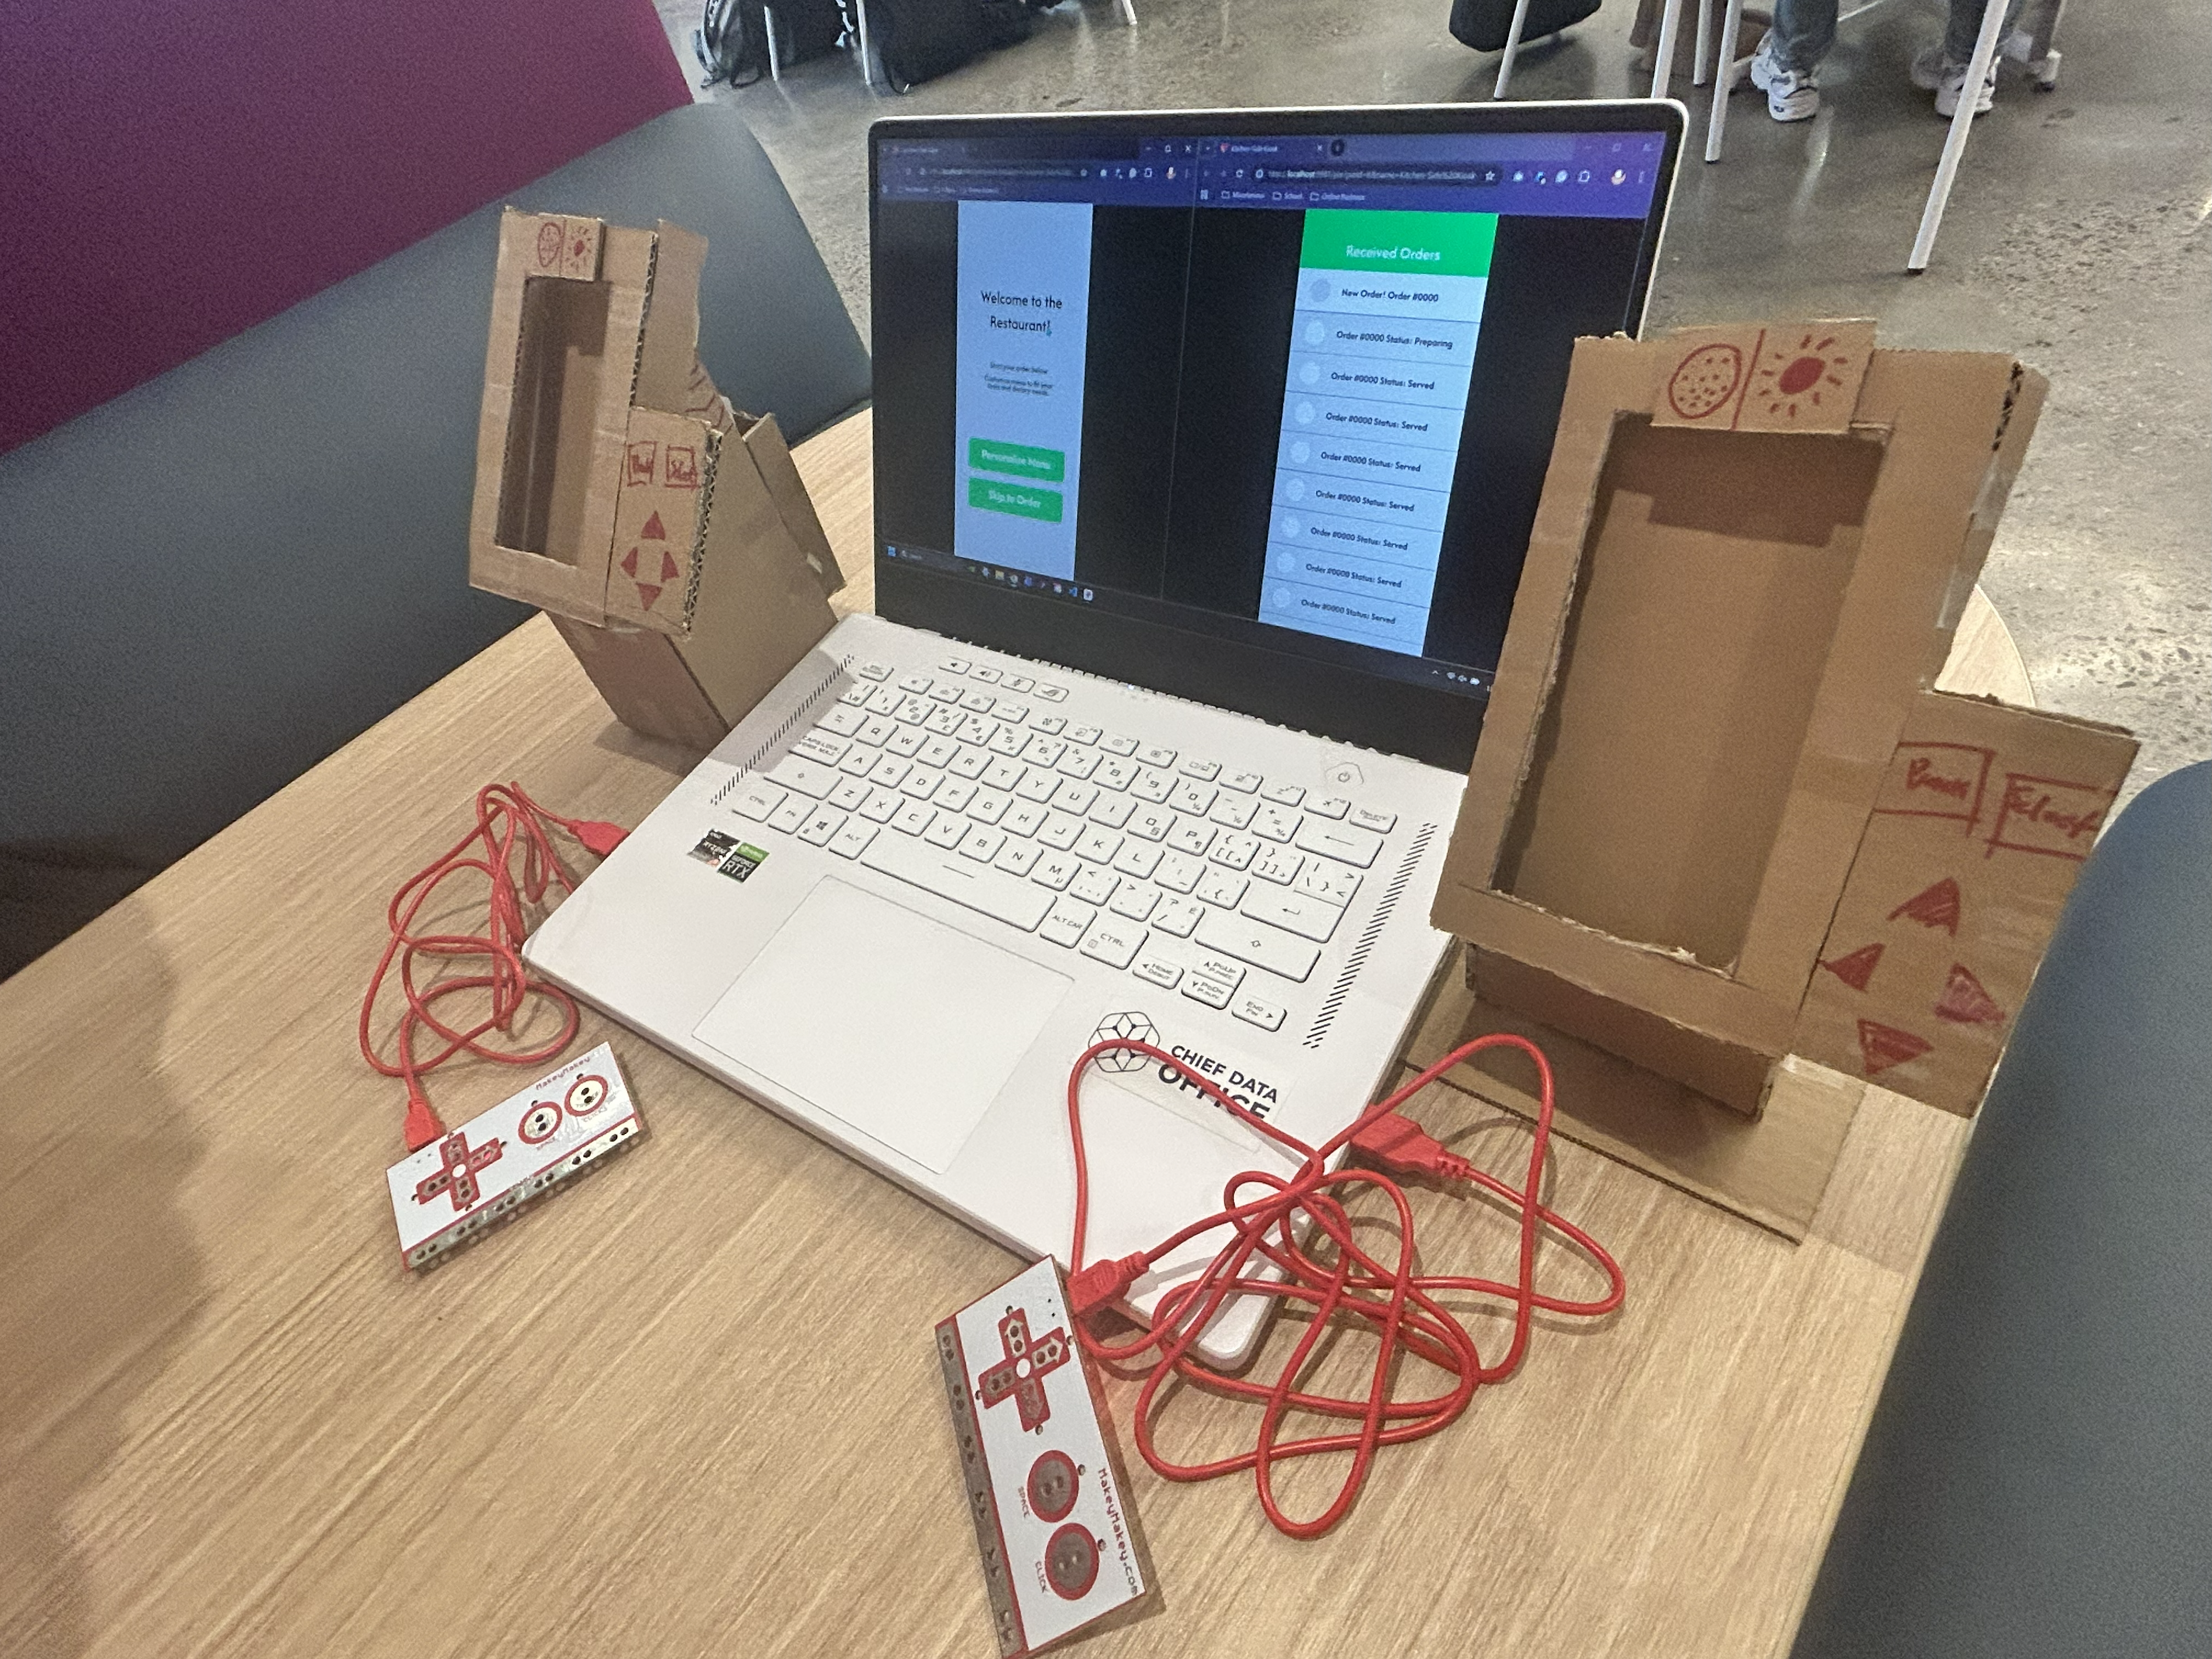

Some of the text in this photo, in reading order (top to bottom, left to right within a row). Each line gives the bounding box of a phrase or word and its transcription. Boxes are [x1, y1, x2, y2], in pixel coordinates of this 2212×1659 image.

[1346, 245, 1441, 261] Received Orders
[980, 290, 1062, 309] Welcome to the
[1361, 290, 1386, 298] Order!
[1388, 291, 1411, 301] Order
[1413, 293, 1438, 302] #0000
[991, 315, 1051, 332] Restaurant!
[1336, 331, 1453, 350] Order #0000 Status: Preparing
[1331, 372, 1435, 390] Order #0000 Status: Served
[1326, 413, 1428, 432] Order #0000 Status: Served
[1321, 452, 1421, 472] Order #0000 Status: Served
[989, 490, 1041, 509] Skip to Order
[1316, 490, 1414, 511] Order #0000 Status: Served
[1311, 527, 1408, 550] Order #0000 Status: Served
[1306, 563, 1402, 588] Order #0000 Status: Served
[1301, 599, 1396, 624] Order #0000 Status: Served
[901, 736, 913, 745] W
[933, 747, 943, 755] E
[749, 795, 765, 806] CTRL
[1069, 792, 1080, 800] U
[876, 801, 887, 809] X
[983, 802, 994, 810] G
[1018, 814, 1030, 822] H
[977, 839, 987, 848] B
[1093, 840, 1104, 849] K
[1012, 852, 1024, 860] N
[1132, 854, 1141, 862] L
[722, 860, 751, 878] RTX
[1049, 865, 1062, 874] M
[1052, 915, 1066, 923] ALT
[1100, 933, 1124, 947] CTRL
[1171, 1045, 1278, 1103] CHIEF DATA
[1018, 1486, 1030, 1519] SPACE
[1098, 1468, 1138, 1596] MakeyMakey.com
[1035, 1560, 1048, 1593] CLICK
